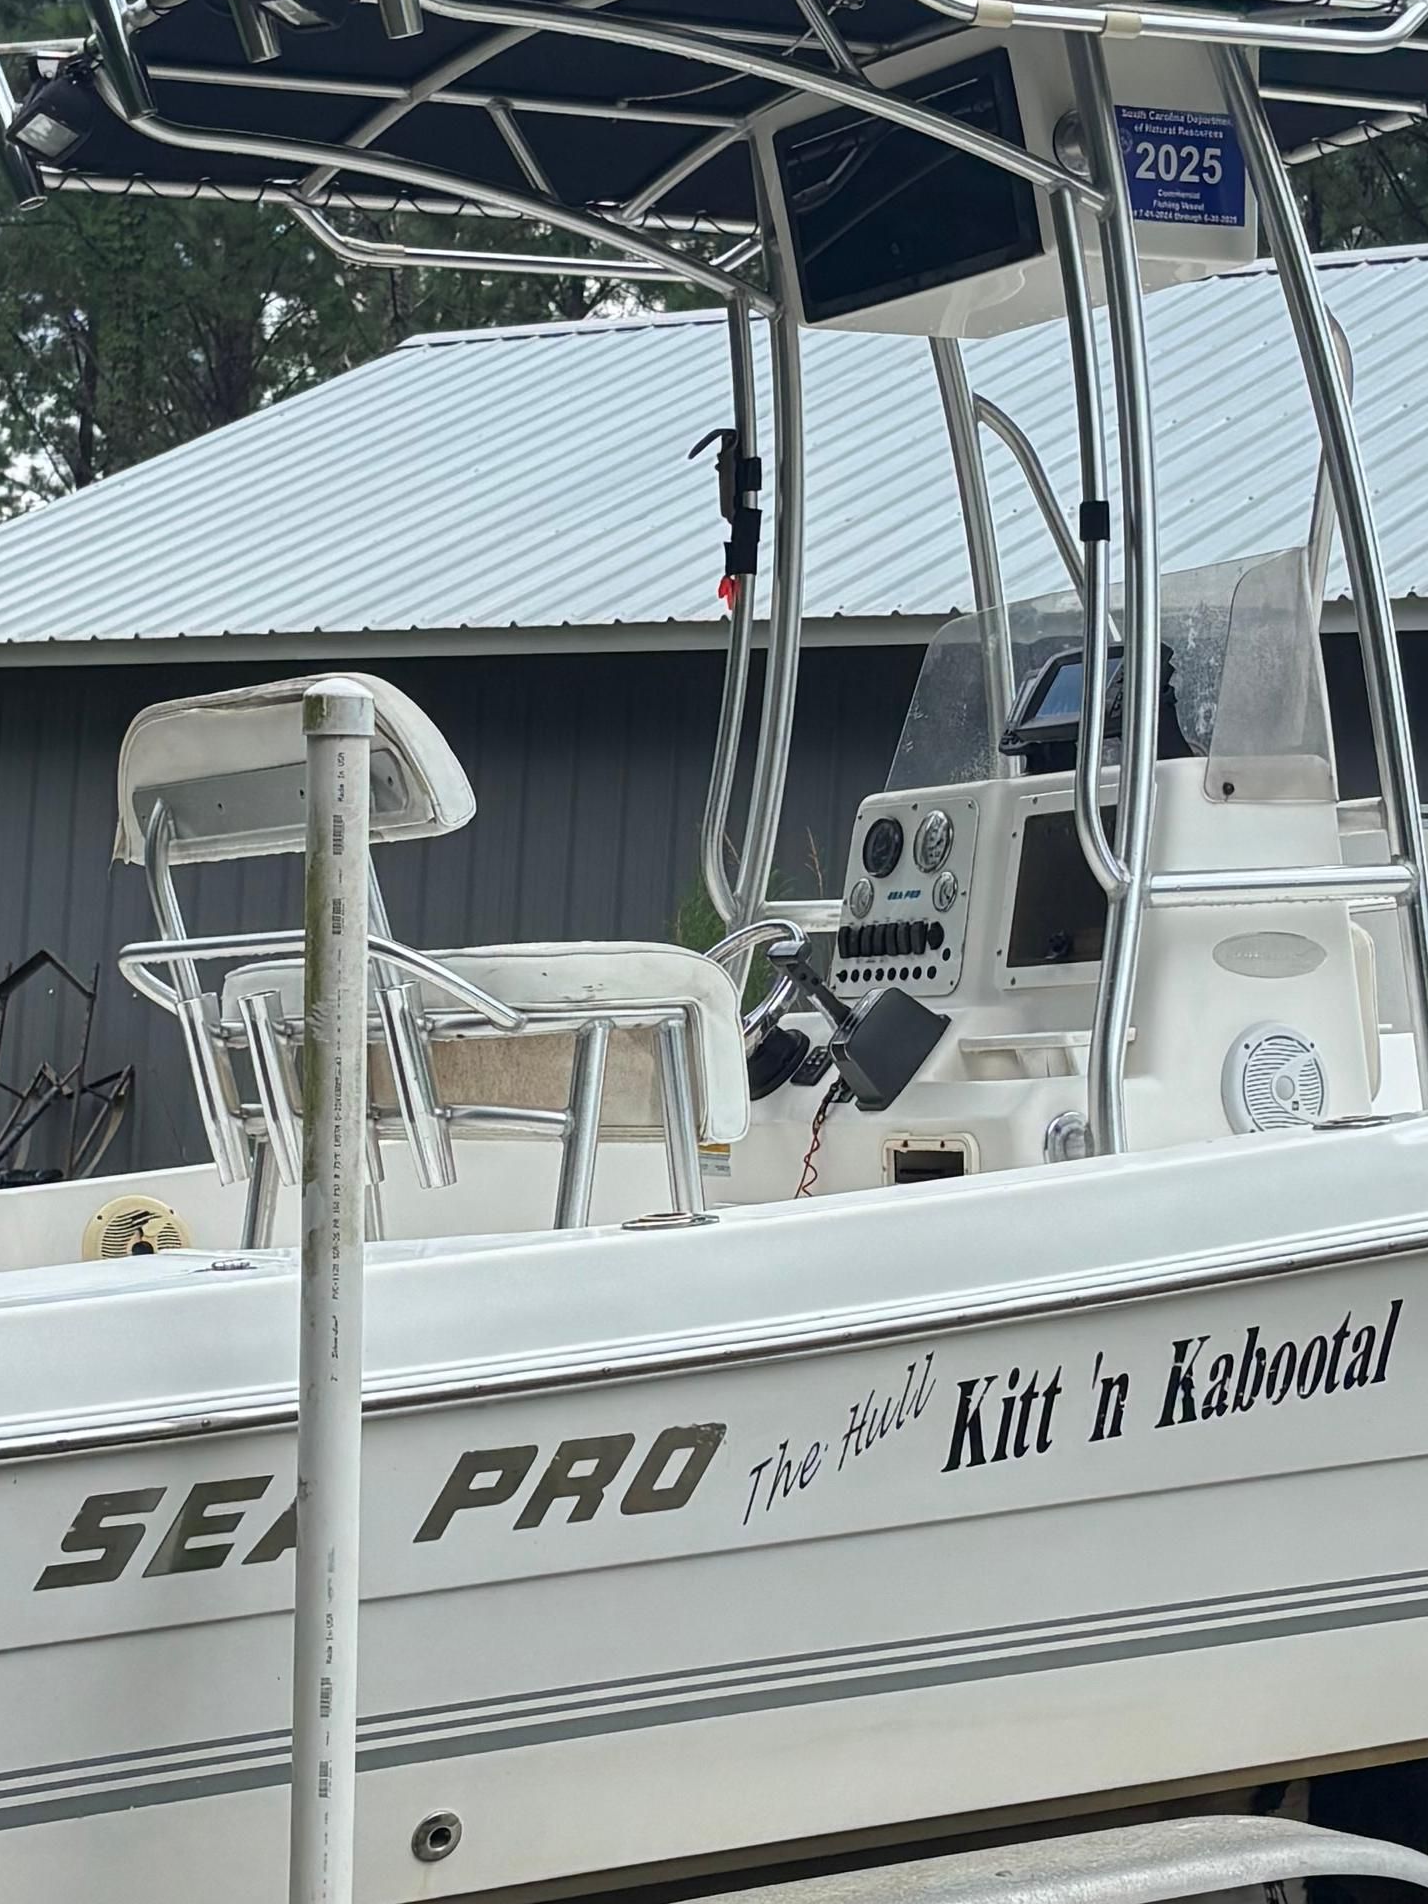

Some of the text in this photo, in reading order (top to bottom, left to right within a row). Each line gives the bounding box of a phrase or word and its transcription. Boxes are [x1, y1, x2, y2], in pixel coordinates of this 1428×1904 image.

[1134, 123, 1224, 139] of Natural Resources
[1148, 110, 1184, 123] Carolina
[1135, 141, 1223, 185] 2025
[337, 752, 345, 767] USA
[743, 1299, 1404, 1526] The Hull Kitt 'n Kabootal
[413, 1422, 727, 1543] PRO
